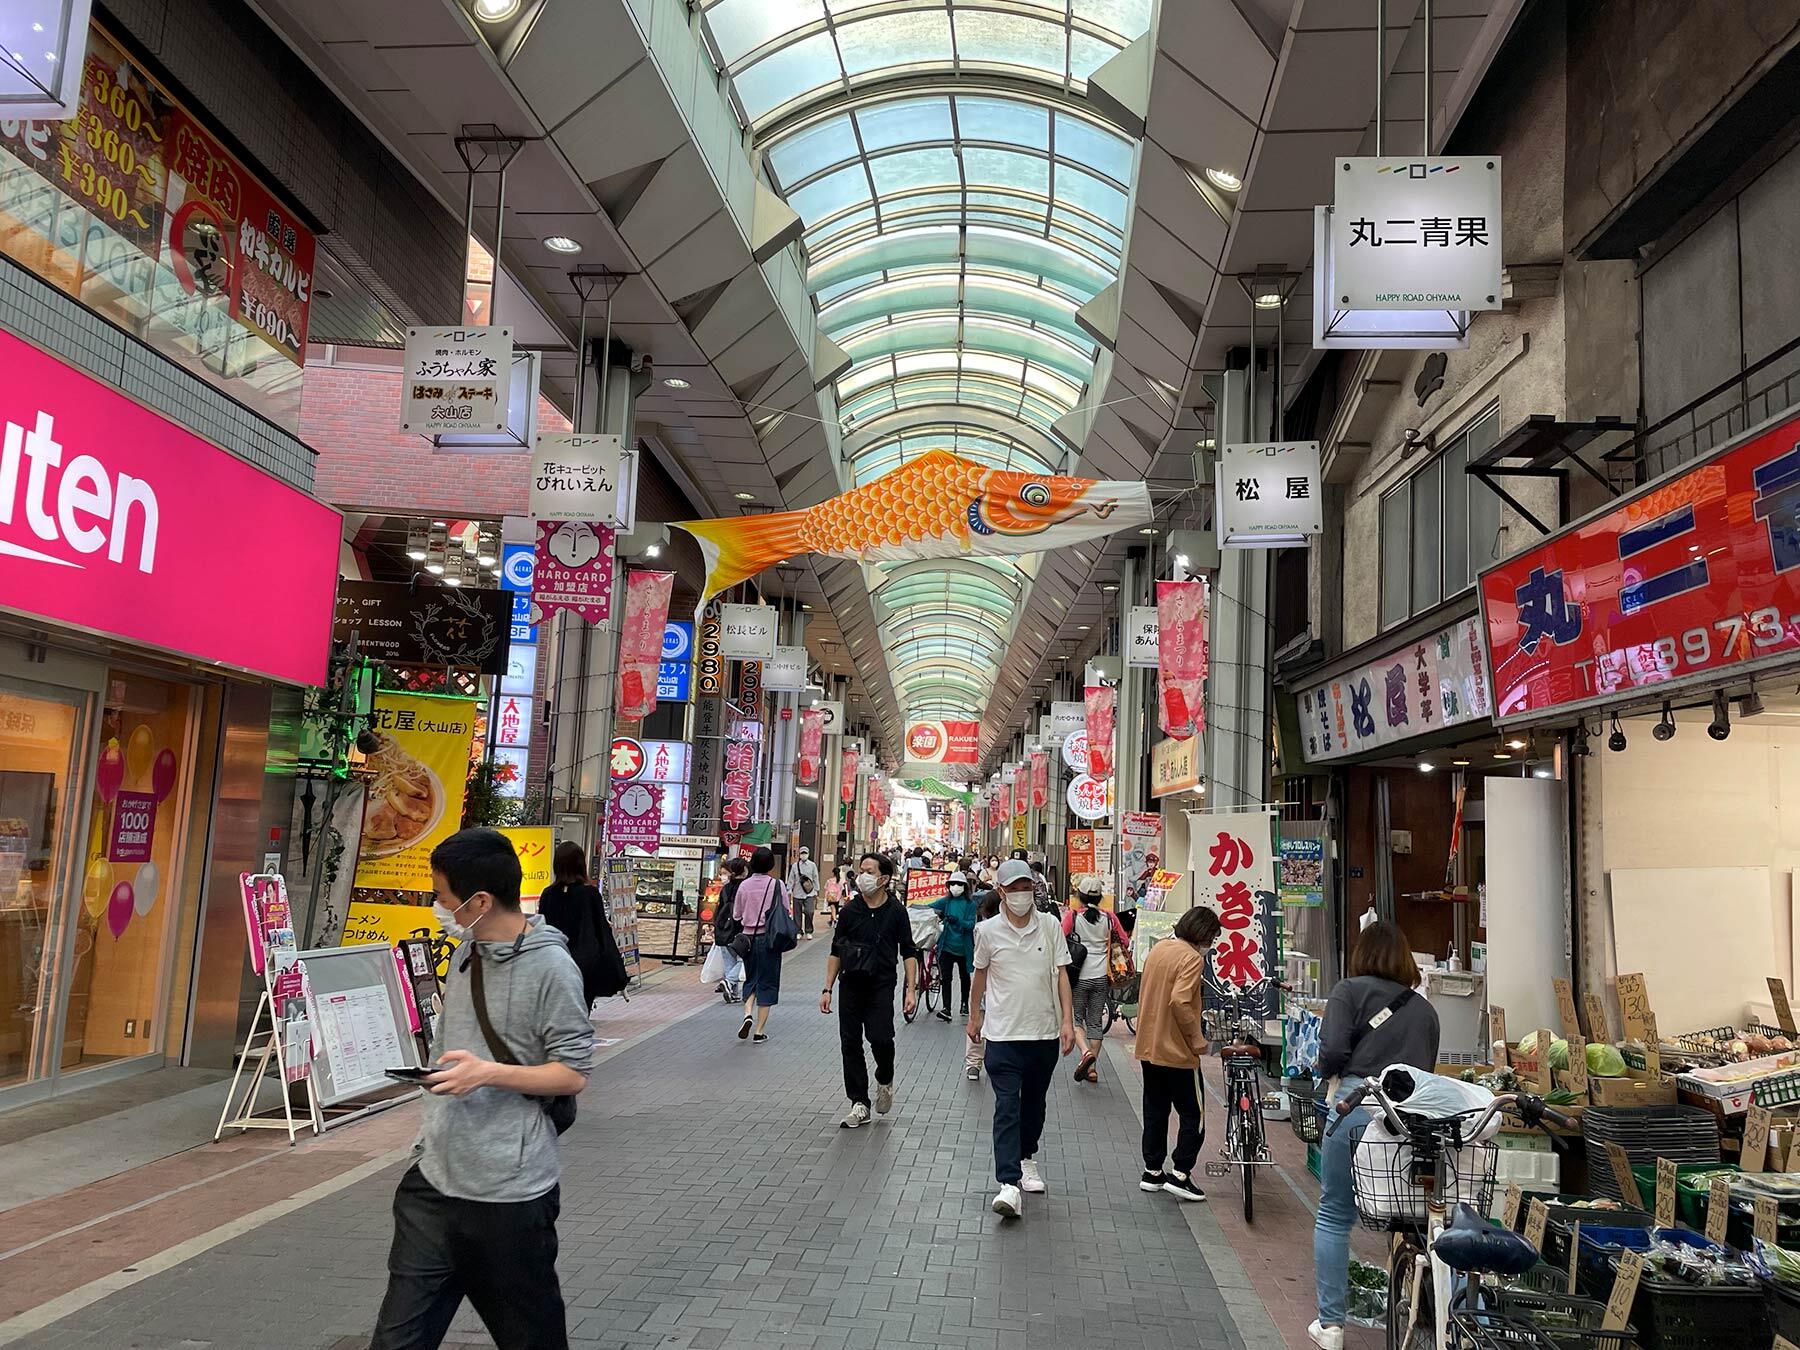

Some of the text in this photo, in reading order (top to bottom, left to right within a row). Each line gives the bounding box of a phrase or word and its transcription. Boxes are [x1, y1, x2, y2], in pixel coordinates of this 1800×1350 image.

[1350, 217, 1489, 247] 丸二青果
[239, 217, 311, 302] 和牛カルビ
[1376, 294, 1400, 302] HAPPY
[1402, 294, 1424, 302] ROAD
[416, 358, 497, 377] ふうちゃん家
[458, 386, 493, 400] ステーキ
[431, 405, 472, 419] 大山店
[543, 462, 606, 475] 花キューピット
[536, 477, 613, 492] びれいえん
[537, 570, 607, 582] HARO CARD
[554, 582, 588, 592] 加盟店
[369, 619, 402, 627] LESSON
[726, 624, 768, 636] 松長ビル
[1174, 595, 1187, 667] さくらまつり
[501, 698, 520, 743] 大地屋
[654, 744, 670, 780] 大地屋
[121, 812, 150, 830] 1000
[612, 818, 634, 826] HARO
[1208, 832, 1265, 988] かき氷
[344, 929, 390, 941] つけめん
[1623, 994, 1646, 1016] 130
